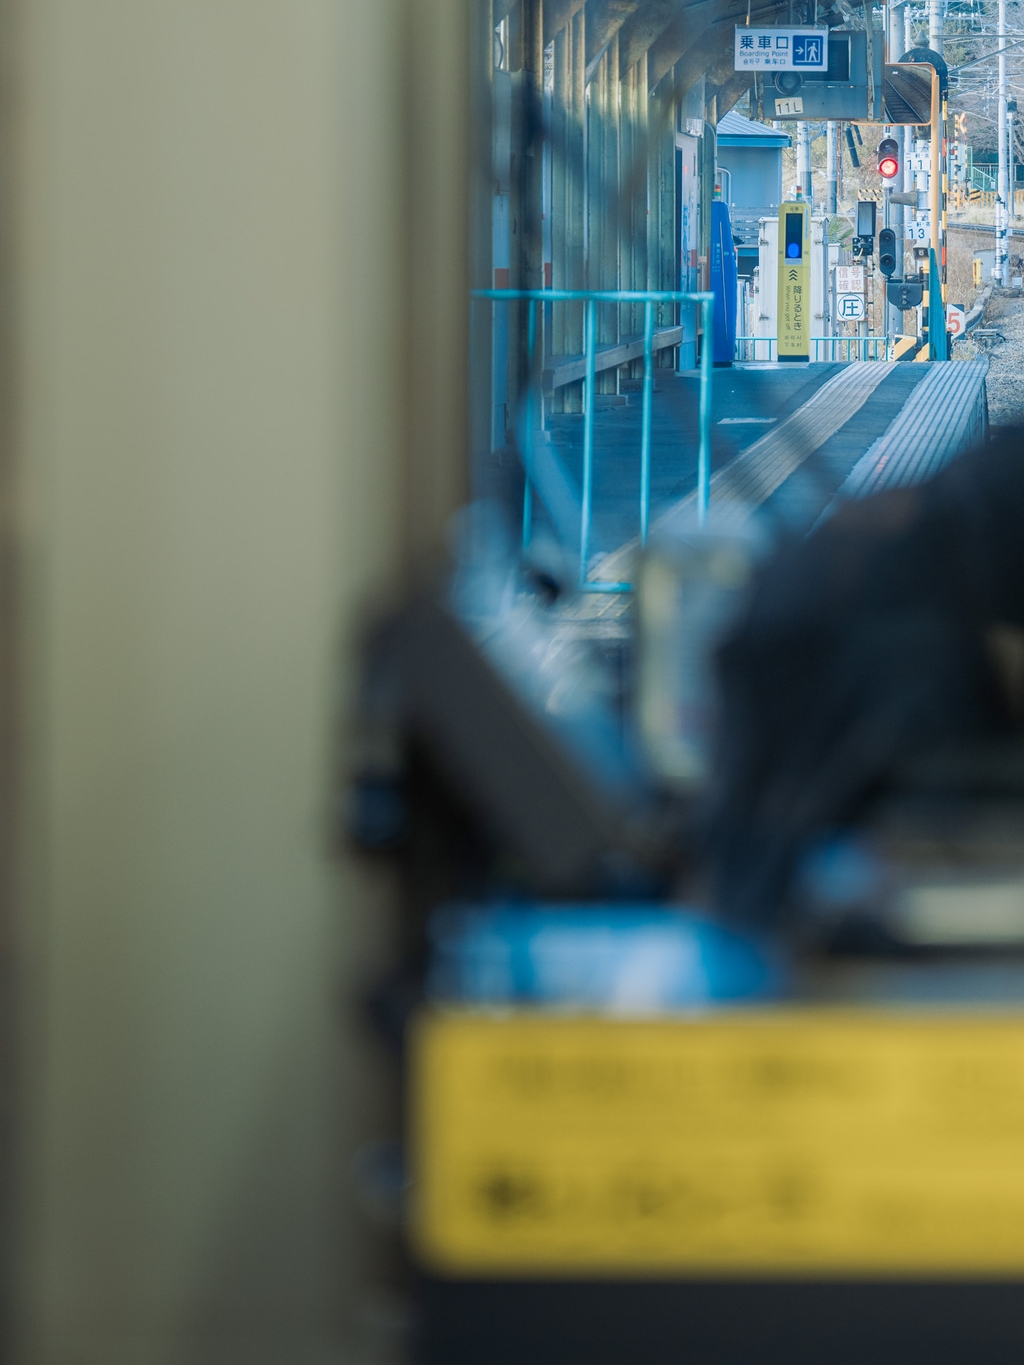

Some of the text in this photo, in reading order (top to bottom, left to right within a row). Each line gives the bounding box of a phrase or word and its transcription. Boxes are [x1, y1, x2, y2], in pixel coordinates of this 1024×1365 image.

[740, 35, 789, 49] 乗車口
[739, 50, 769, 58] Boarding
[776, 101, 802, 114] 11L
[908, 228, 925, 239] 13
[838, 267, 861, 278] 信号
[793, 285, 802, 331] 降りるとき
[842, 299, 859, 316] 圧
